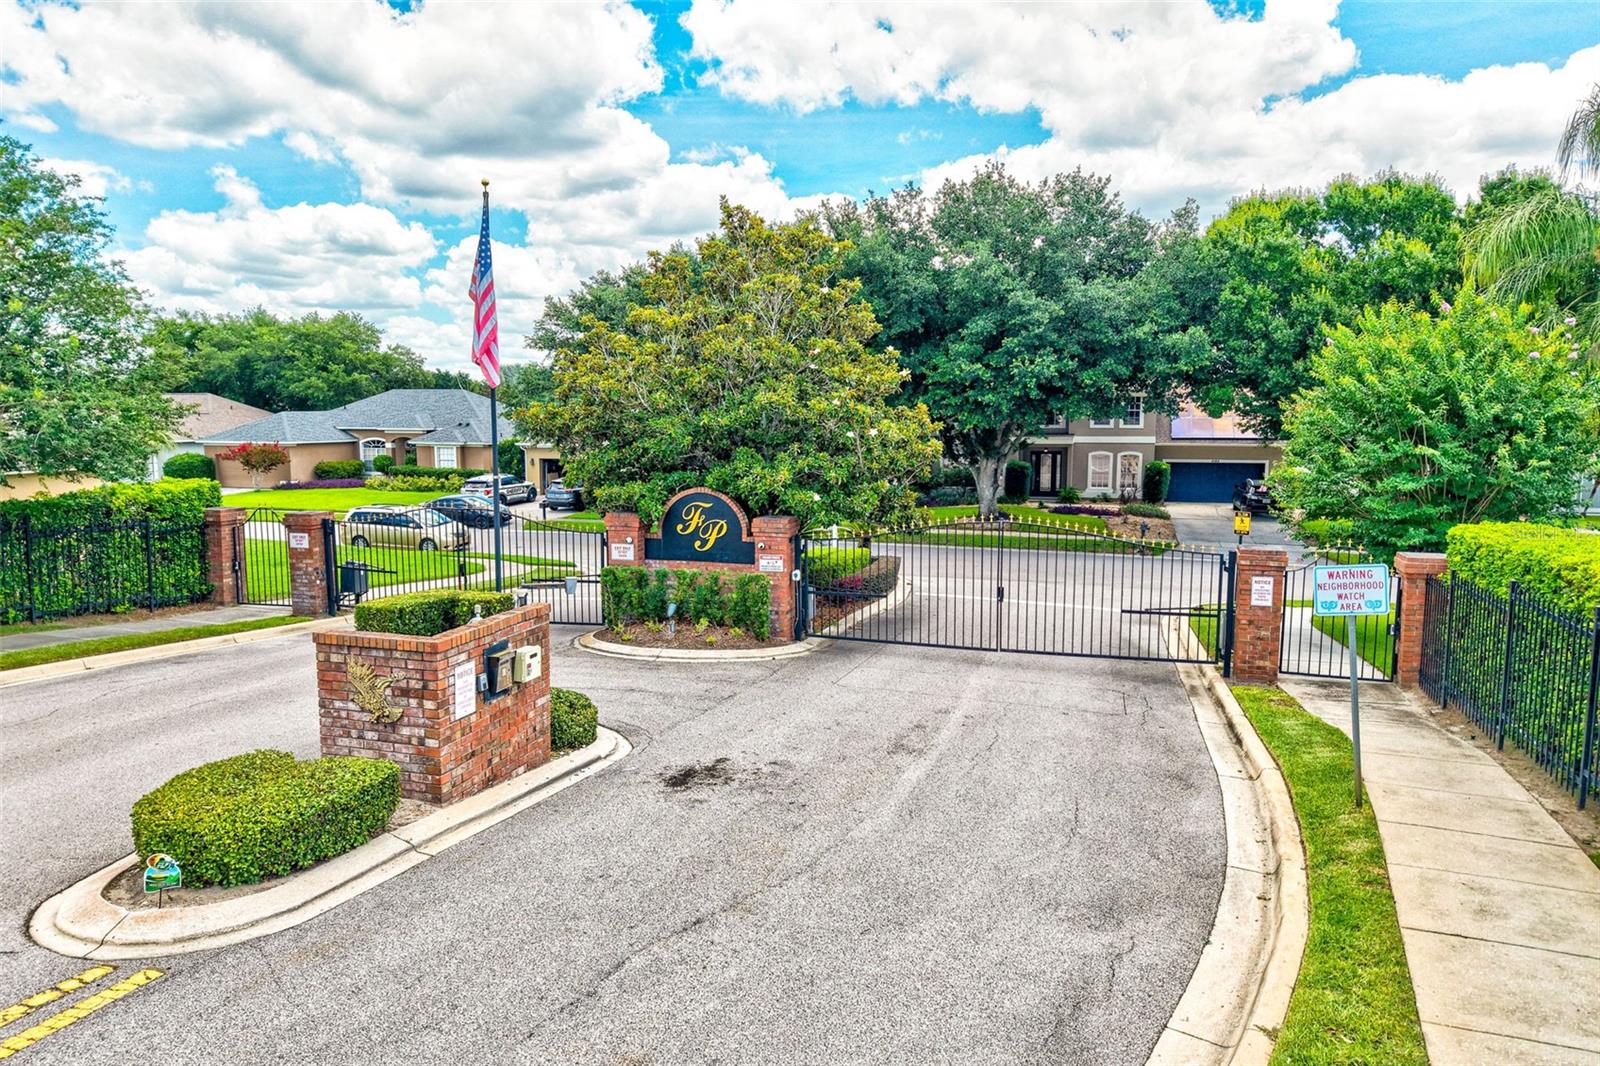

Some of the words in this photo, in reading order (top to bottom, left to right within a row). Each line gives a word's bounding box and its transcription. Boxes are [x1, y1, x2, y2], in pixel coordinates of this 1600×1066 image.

[1327, 569, 1374, 580] WARNING
[1317, 581, 1384, 591] NEIGHBORHOOD
[1337, 592, 1365, 600] WATCH
[1340, 603, 1363, 611] AREA
